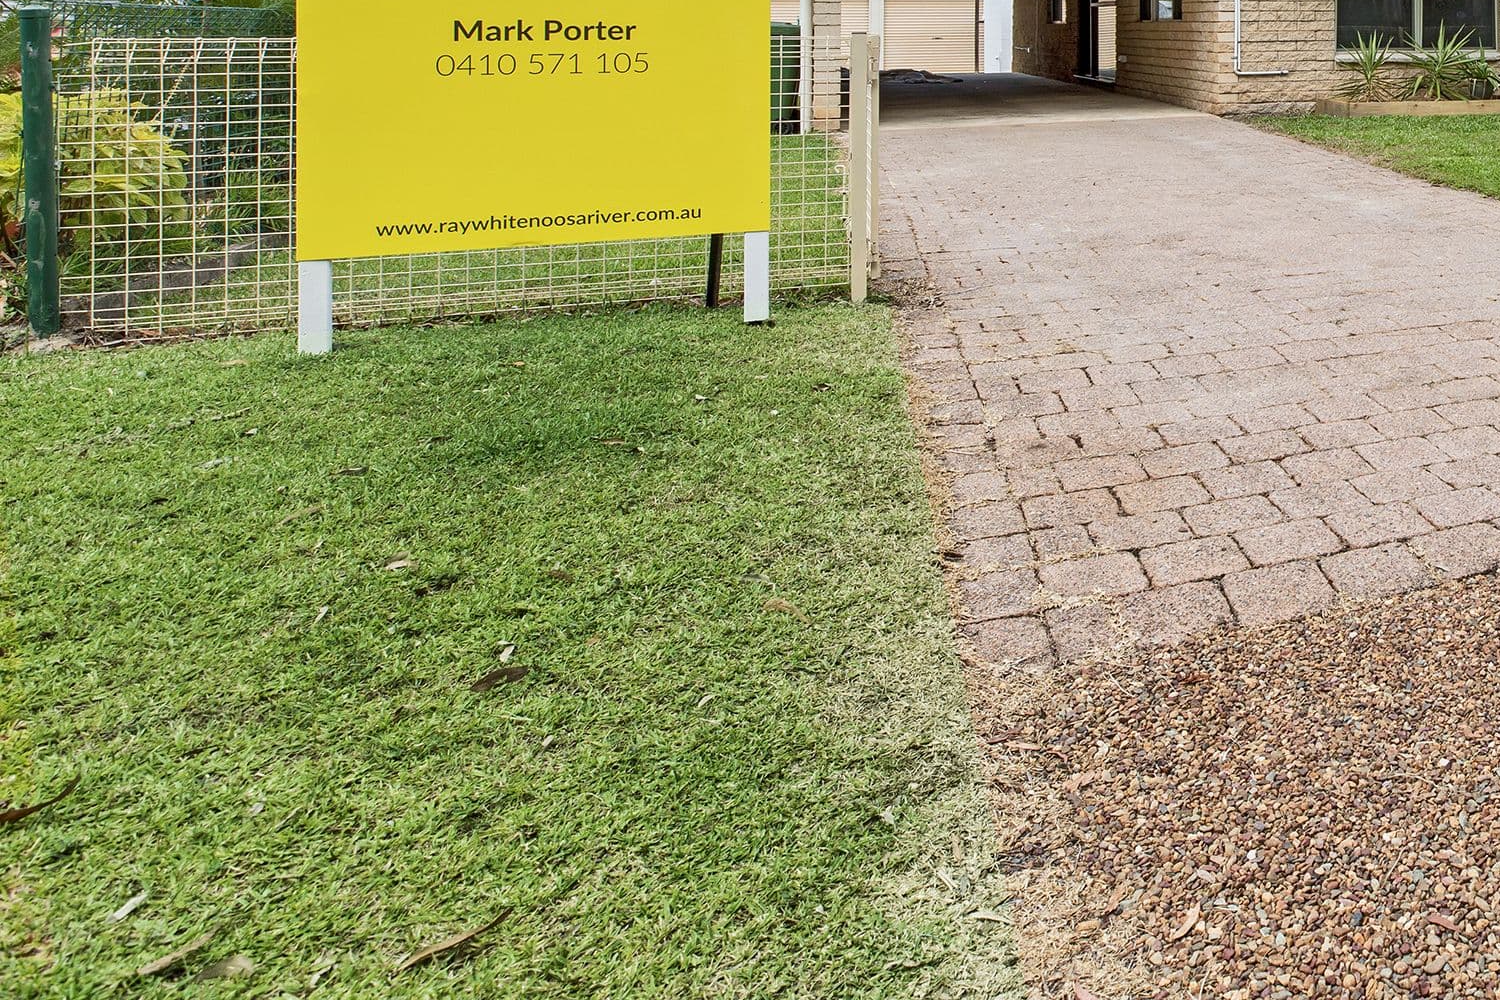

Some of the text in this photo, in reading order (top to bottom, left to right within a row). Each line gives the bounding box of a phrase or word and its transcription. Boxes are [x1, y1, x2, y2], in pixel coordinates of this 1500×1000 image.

[453, 19, 637, 41] Mark Porter
[435, 52, 649, 77] 0410 571 105
[376, 206, 702, 238] www.raywhitenoosariver.com.au
